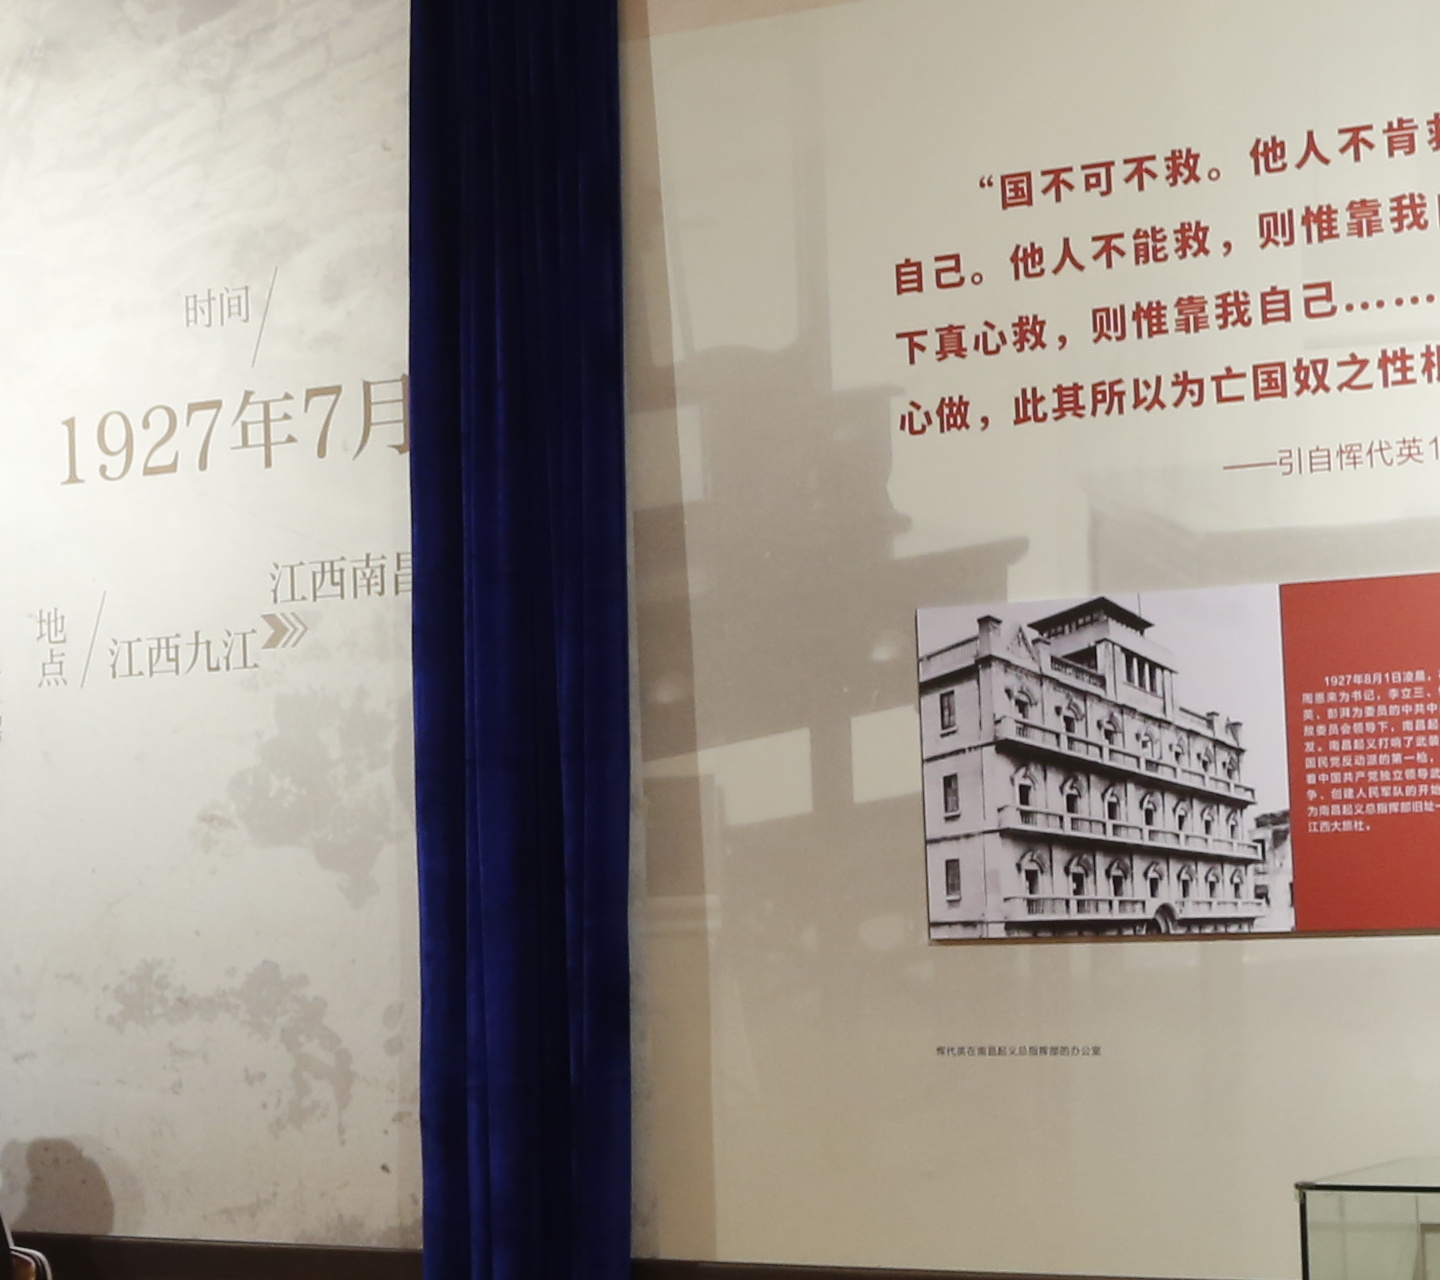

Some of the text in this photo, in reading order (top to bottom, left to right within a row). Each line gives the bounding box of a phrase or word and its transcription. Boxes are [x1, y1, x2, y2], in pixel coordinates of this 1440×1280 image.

[184, 285, 251, 328] 时间
[60, 373, 411, 486] 1927年7月
[268, 552, 413, 605] 江西南昌
[36, 606, 68, 688] 地点
[108, 628, 260, 680] 江西九江
